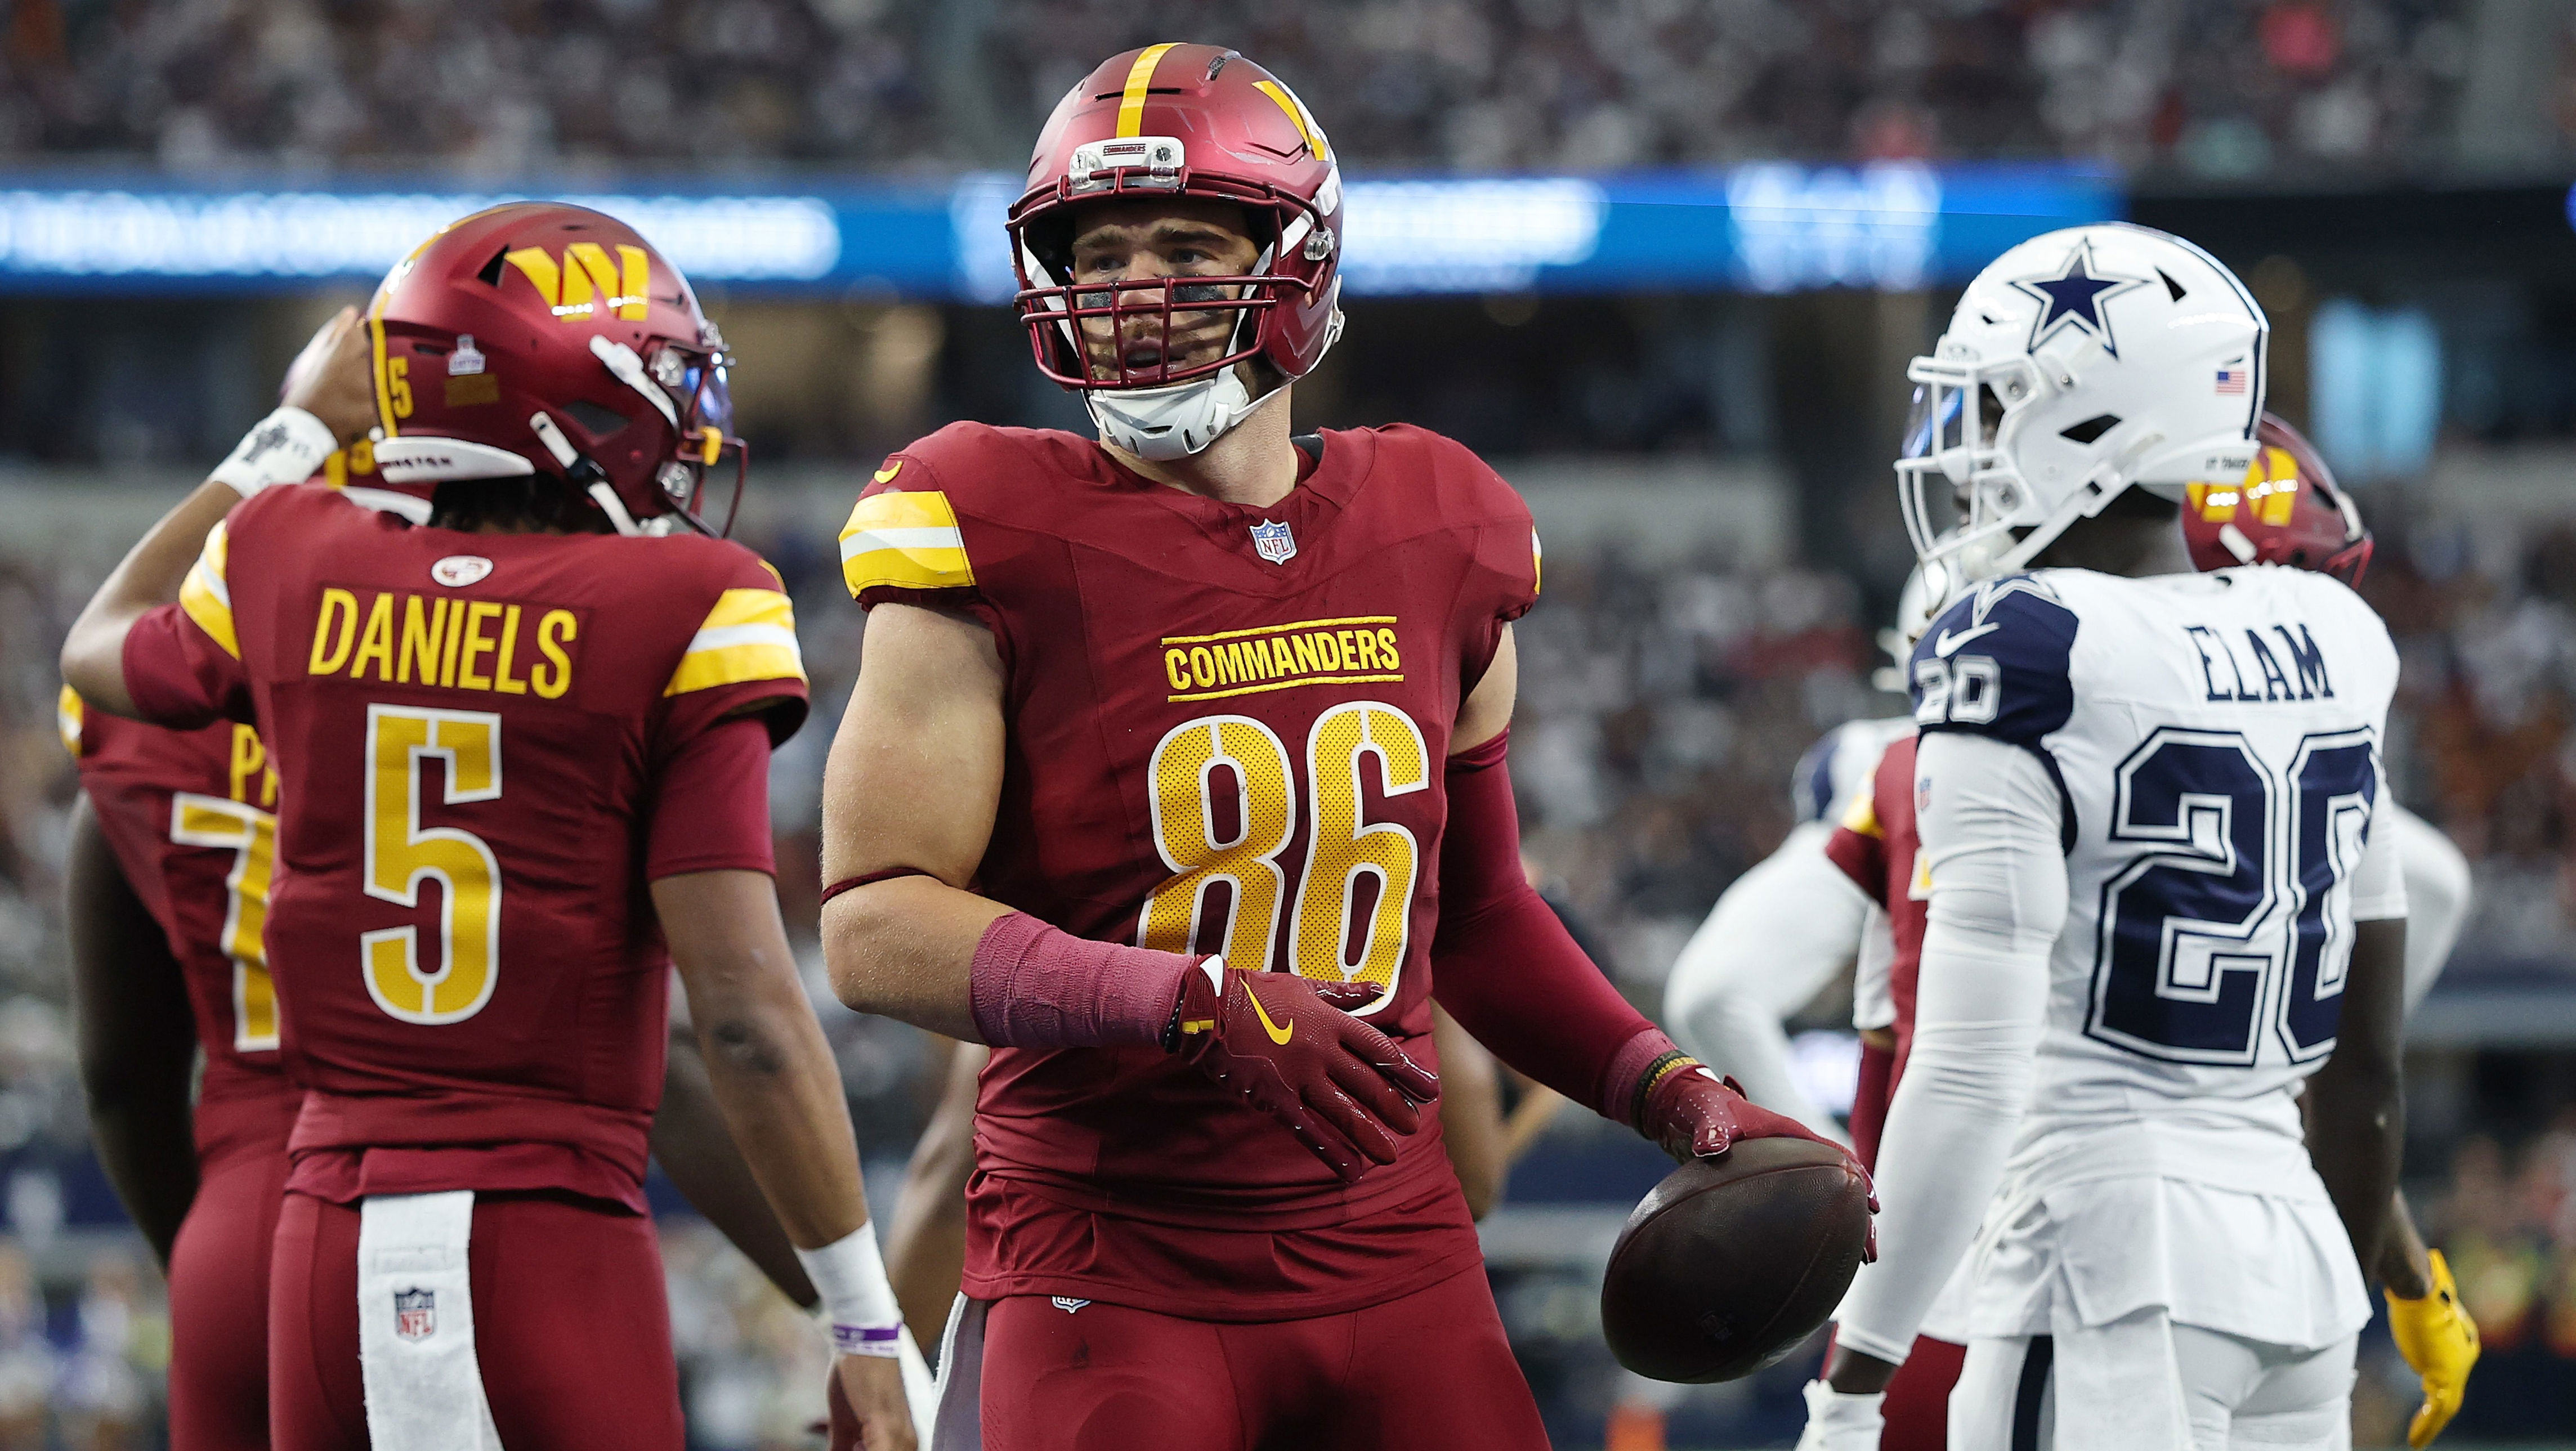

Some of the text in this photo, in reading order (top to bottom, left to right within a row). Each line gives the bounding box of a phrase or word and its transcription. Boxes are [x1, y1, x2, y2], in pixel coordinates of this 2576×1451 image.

[1103, 146, 1146, 154] COMMANDERS
[389, 357, 414, 419] 5
[1262, 539, 1289, 554] NFL
[308, 588, 578, 700] DANIELS
[1165, 628, 1400, 690] COMMANDERS
[2184, 623, 2335, 702] ELAM
[1915, 654, 2002, 726] 20
[360, 702, 503, 1025] 5
[1137, 701, 1430, 1017] 86
[2082, 725, 2377, 1067] 20
[400, 1312, 431, 1336] NFL
